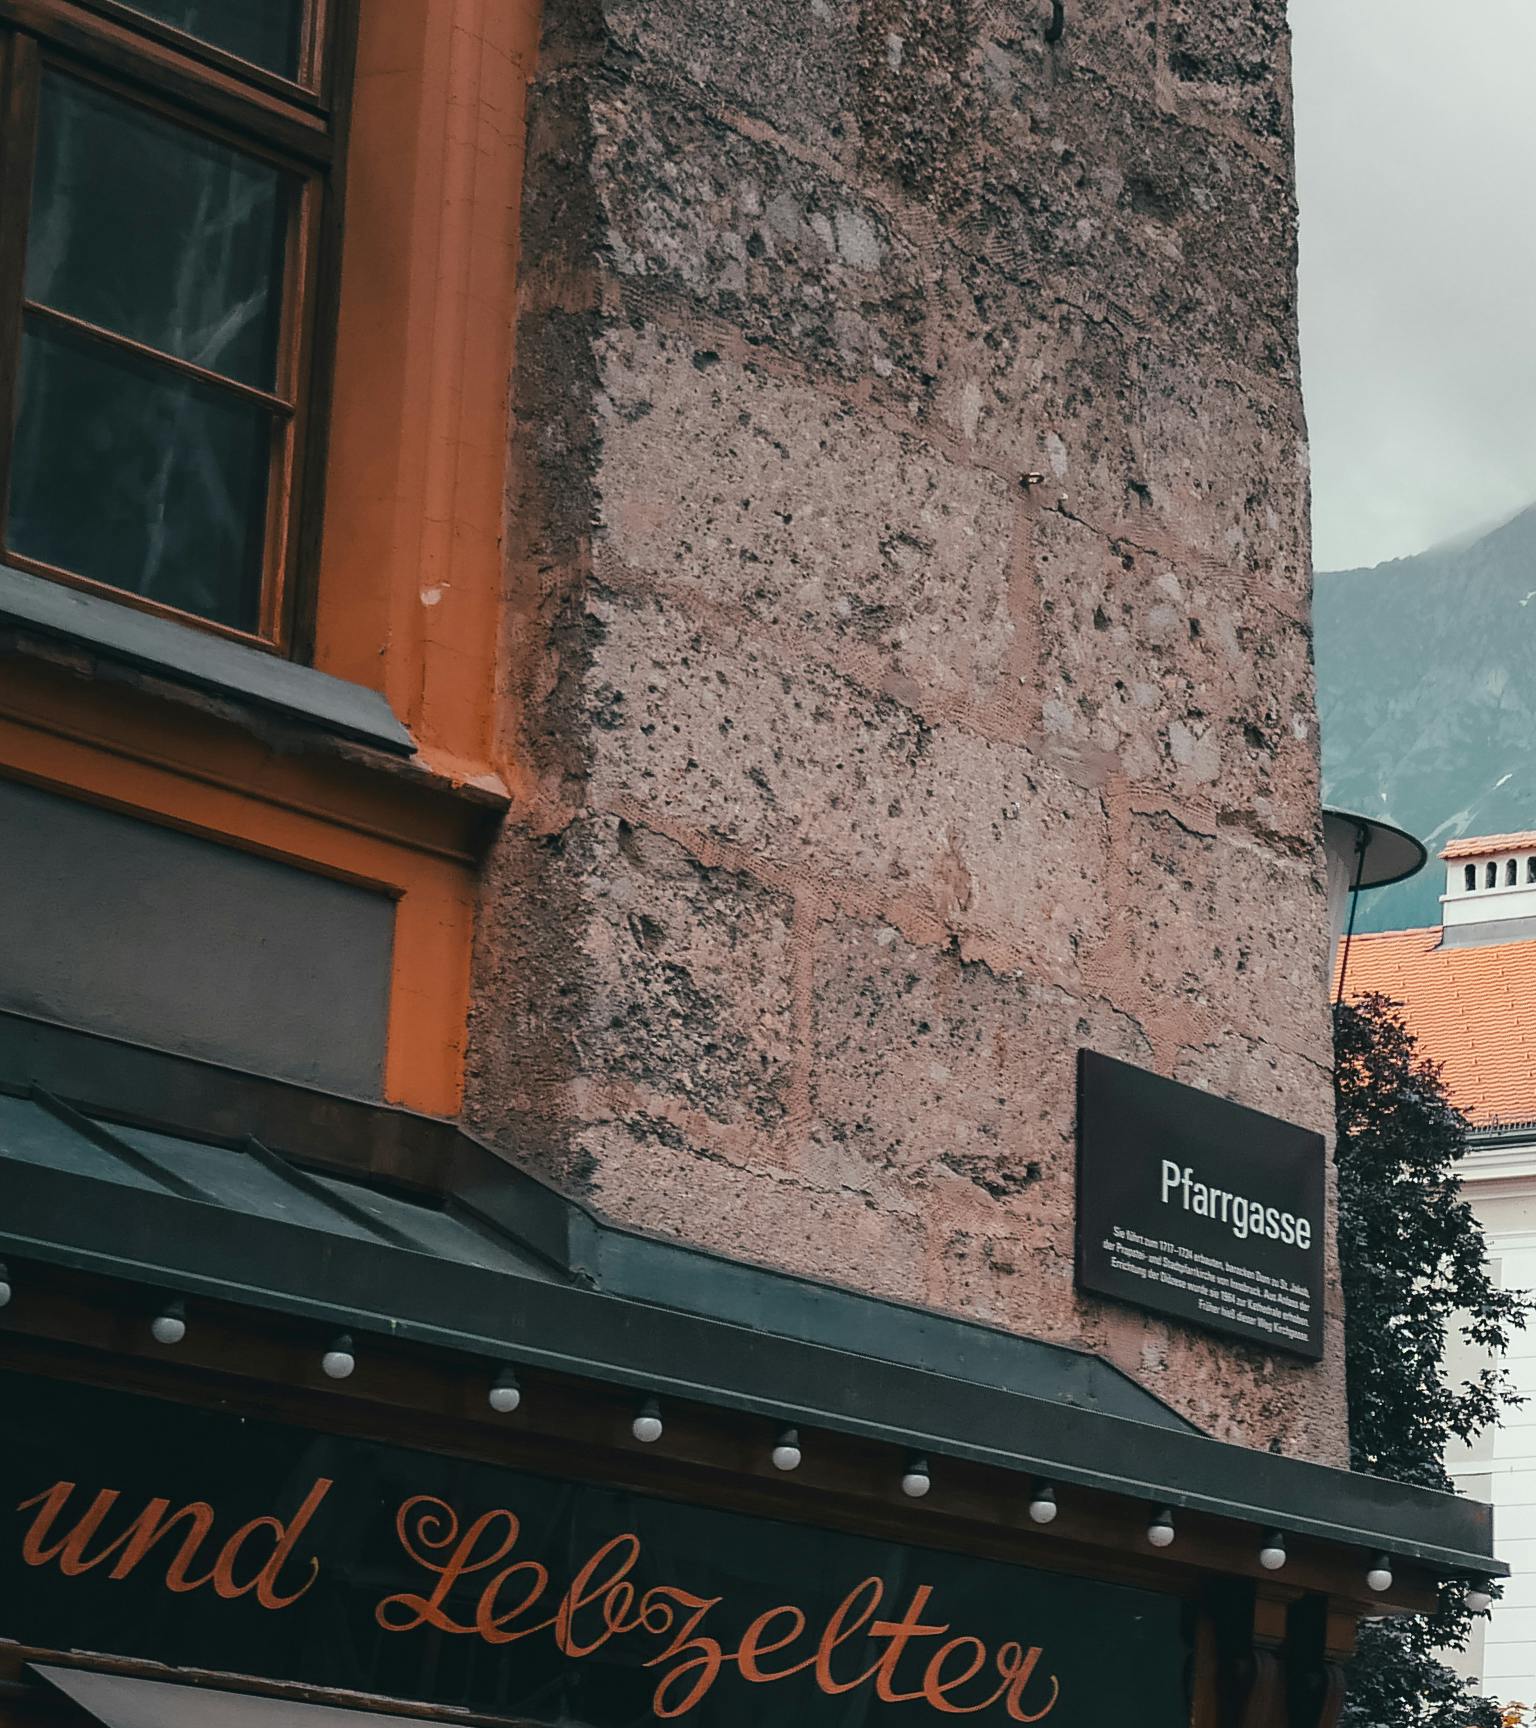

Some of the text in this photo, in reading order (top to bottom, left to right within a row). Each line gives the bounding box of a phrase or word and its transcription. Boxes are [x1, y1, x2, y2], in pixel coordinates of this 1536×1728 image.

[1161, 1159, 1312, 1250] Pfarrgasse
[17, 1477, 1060, 1724] und Lebzelter
